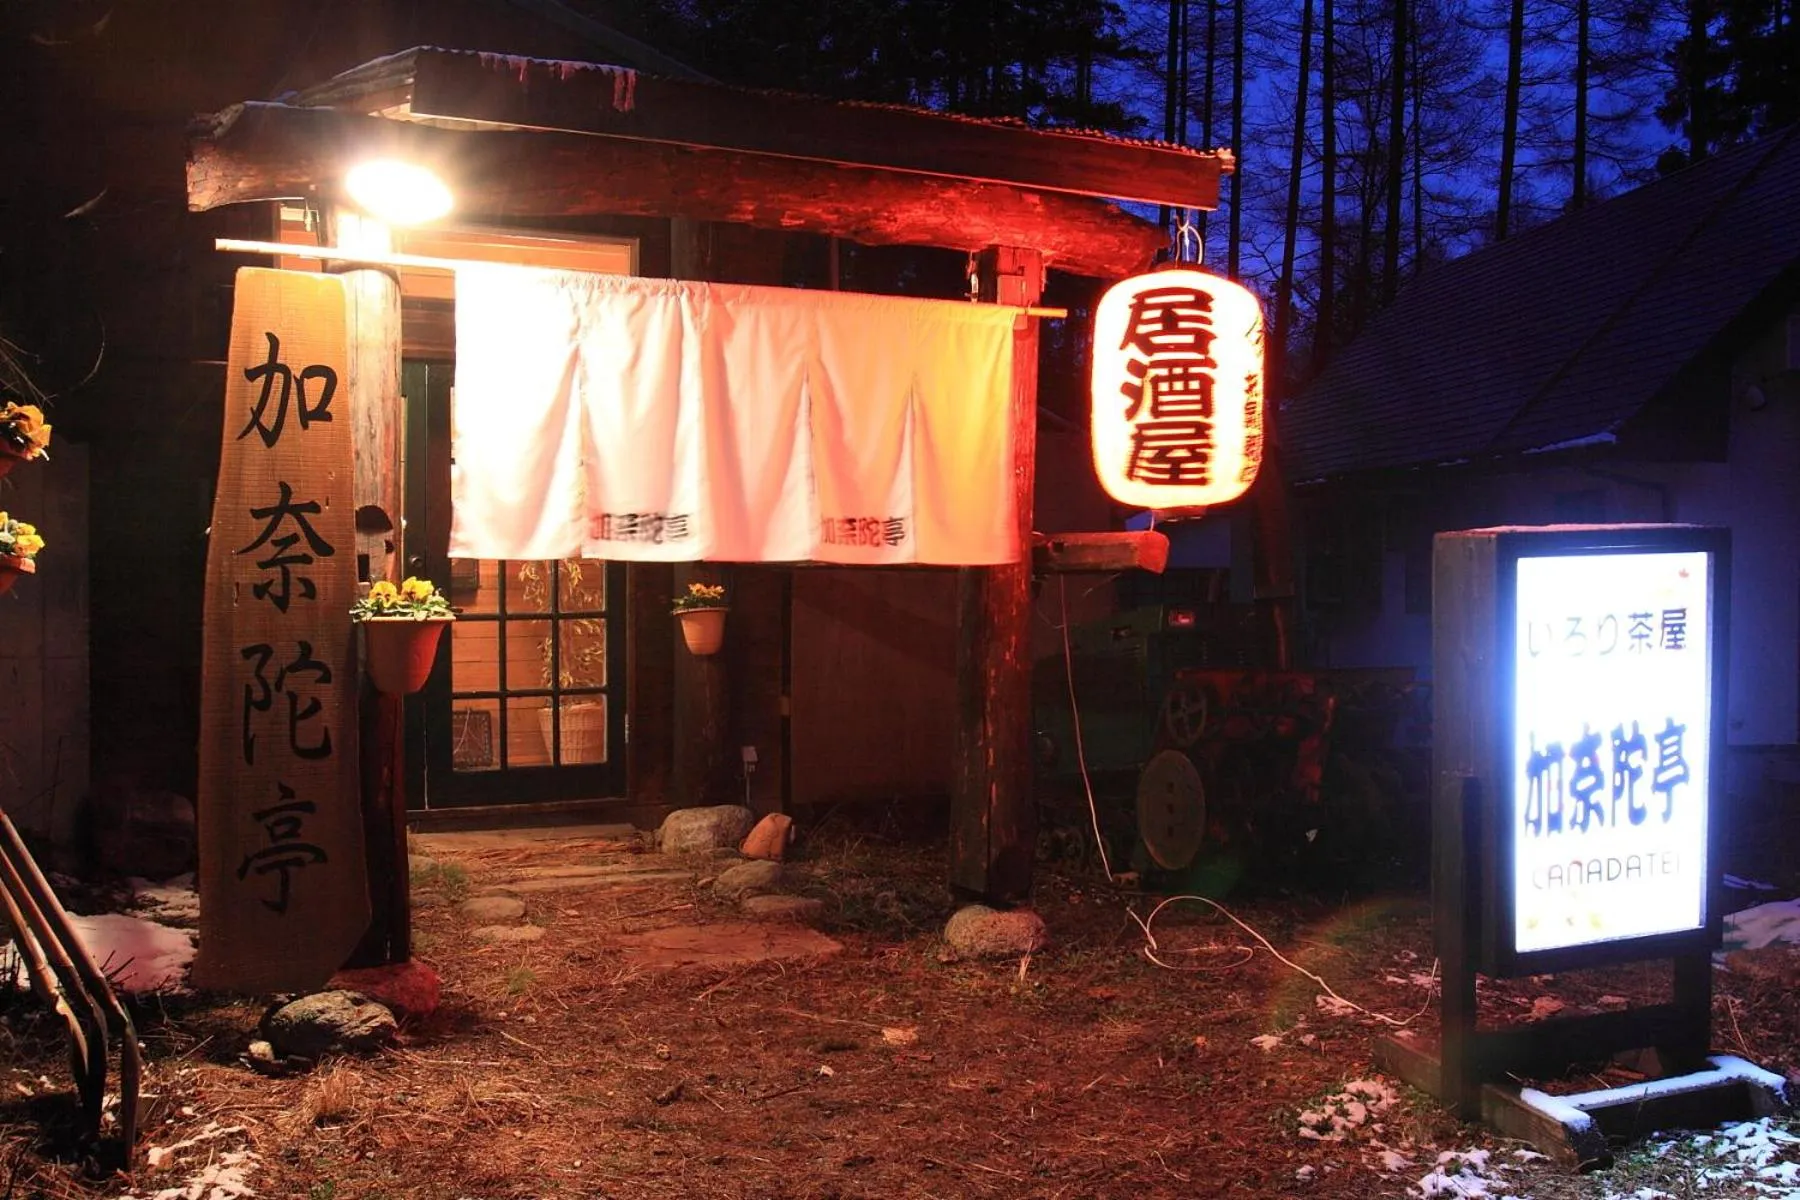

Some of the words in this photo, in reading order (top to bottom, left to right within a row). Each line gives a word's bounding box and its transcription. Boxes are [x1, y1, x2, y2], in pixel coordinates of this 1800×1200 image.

[1120, 287, 1217, 486] 居酒屋
[237, 332, 337, 914] 加奈陀亭
[1528, 606, 1688, 658] いろり茶屋
[1524, 717, 1690, 838] 加奈陀亭
[1532, 851, 1681, 889] CANADATEI
